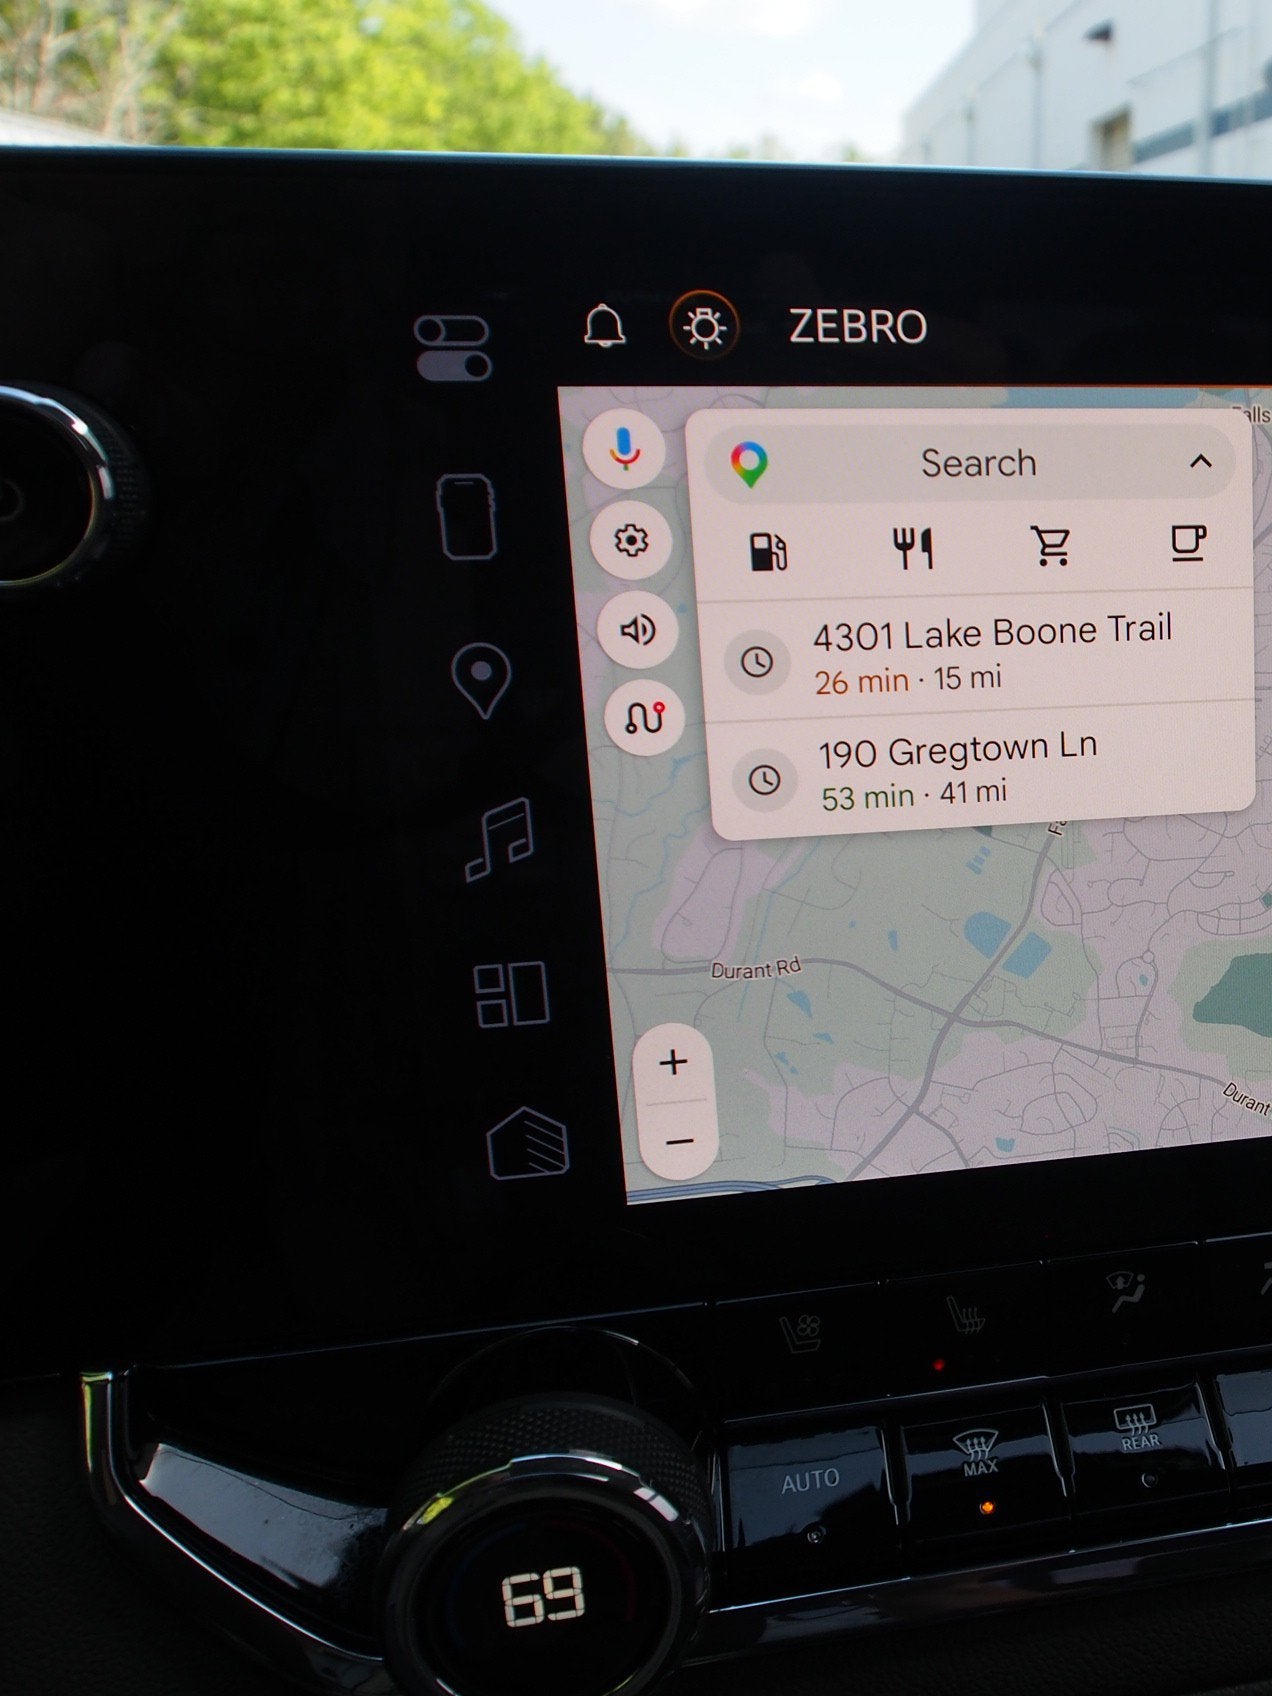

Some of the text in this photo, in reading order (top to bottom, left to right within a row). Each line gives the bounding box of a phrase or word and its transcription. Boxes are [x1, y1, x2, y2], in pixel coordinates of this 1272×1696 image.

[789, 308, 928, 344] ZEBRO
[1232, 405, 1271, 423] alls
[921, 448, 1037, 478] Search
[813, 611, 1172, 652] 4301 Lake Boone Trail
[815, 663, 1002, 695] 26 min 15 mi
[819, 731, 1097, 771] 190 Gregtown Ln
[822, 777, 1007, 811] 53 min 41 mi
[711, 955, 801, 979] Durant Rd
[1223, 1082, 1271, 1116] Durant
[1121, 1434, 1161, 1451] REAR
[780, 1467, 841, 1495] AUTO
[963, 1458, 999, 1478] MAX
[501, 1565, 586, 1628] 69
